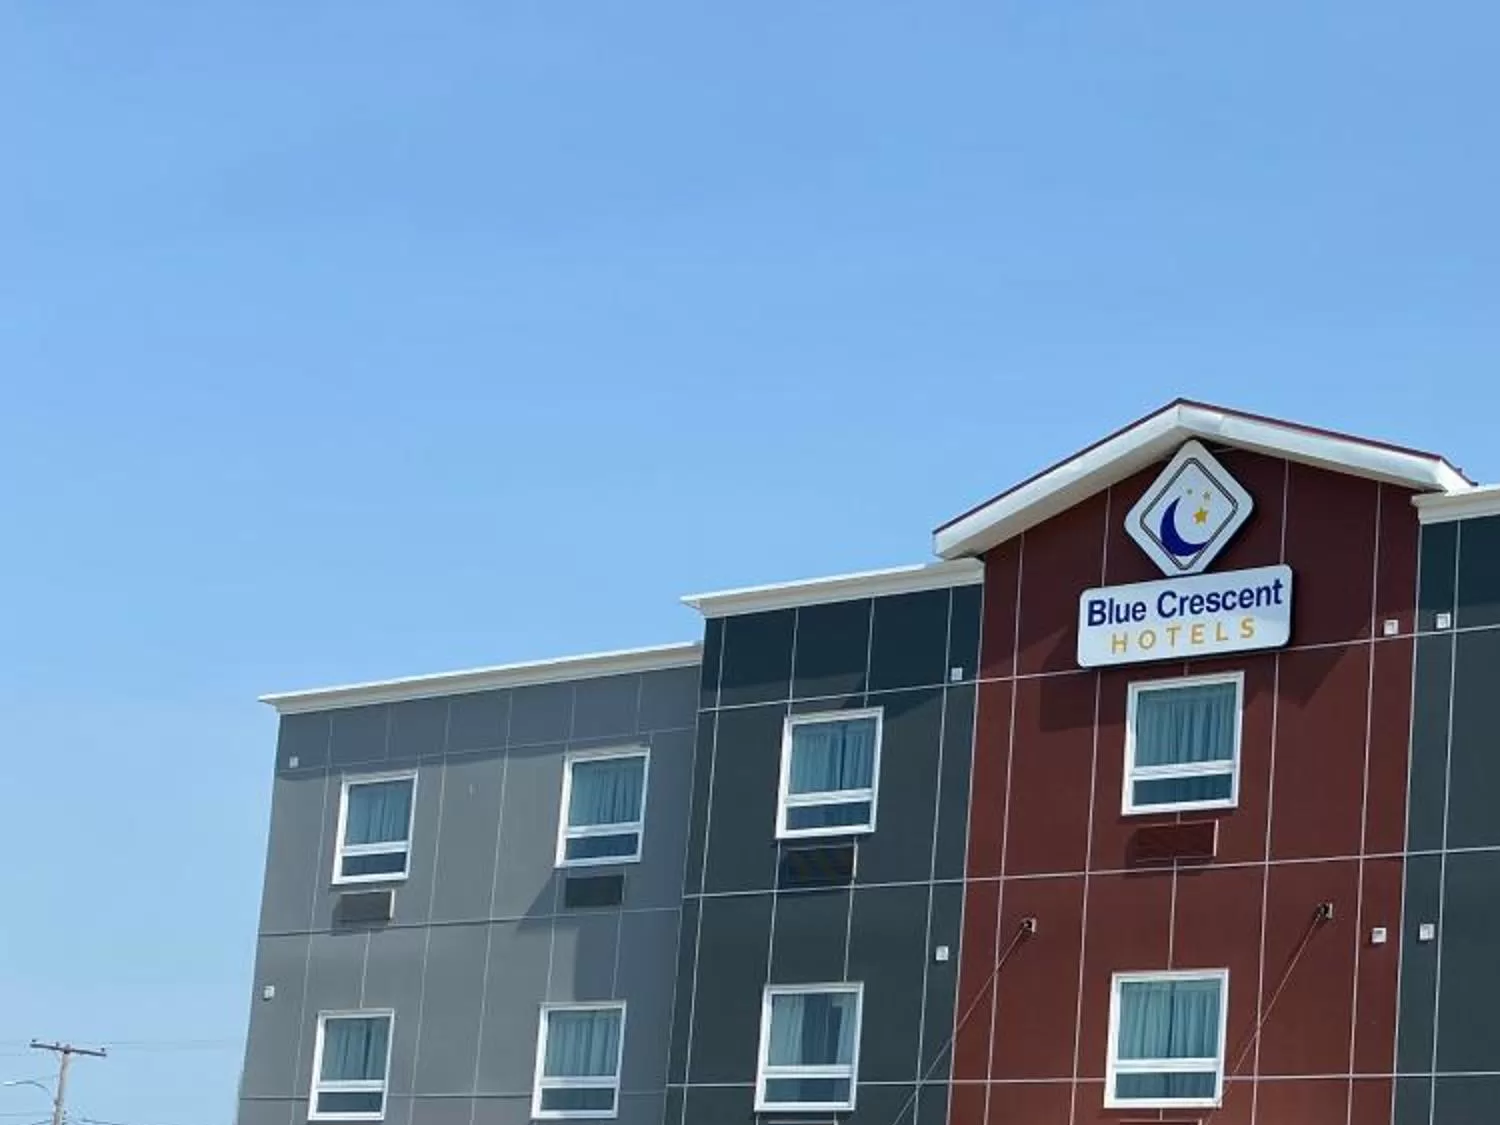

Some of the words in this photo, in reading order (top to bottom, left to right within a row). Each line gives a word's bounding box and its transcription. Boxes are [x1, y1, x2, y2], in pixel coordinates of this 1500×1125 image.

[1087, 598, 1147, 627] Blue
[1157, 578, 1283, 618] Crescent
[1111, 617, 1255, 654] HOTELS
